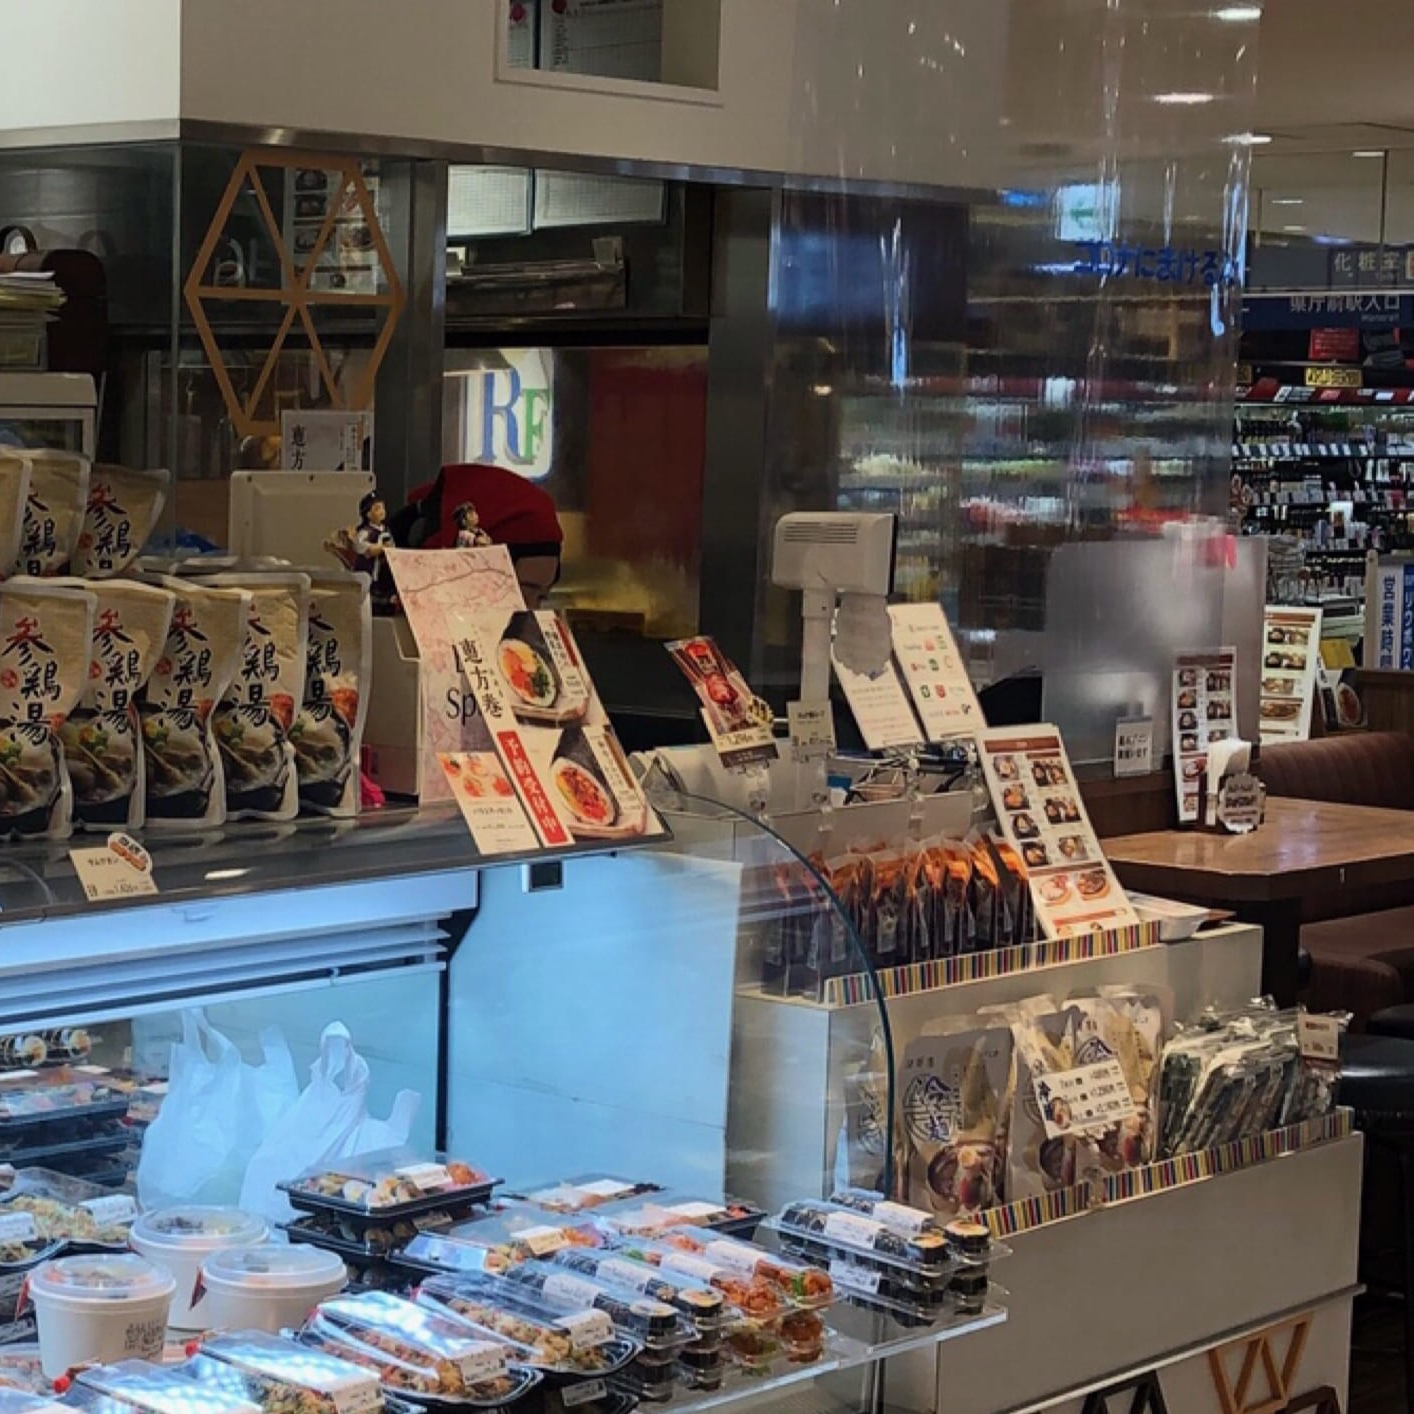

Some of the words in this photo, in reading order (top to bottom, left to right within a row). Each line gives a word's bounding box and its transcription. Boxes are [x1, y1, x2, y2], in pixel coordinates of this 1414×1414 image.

[1334, 252, 1399, 271] 化粧室
[1, 617, 62, 745] 参鶏湯
[446, 687, 482, 726] Sp
